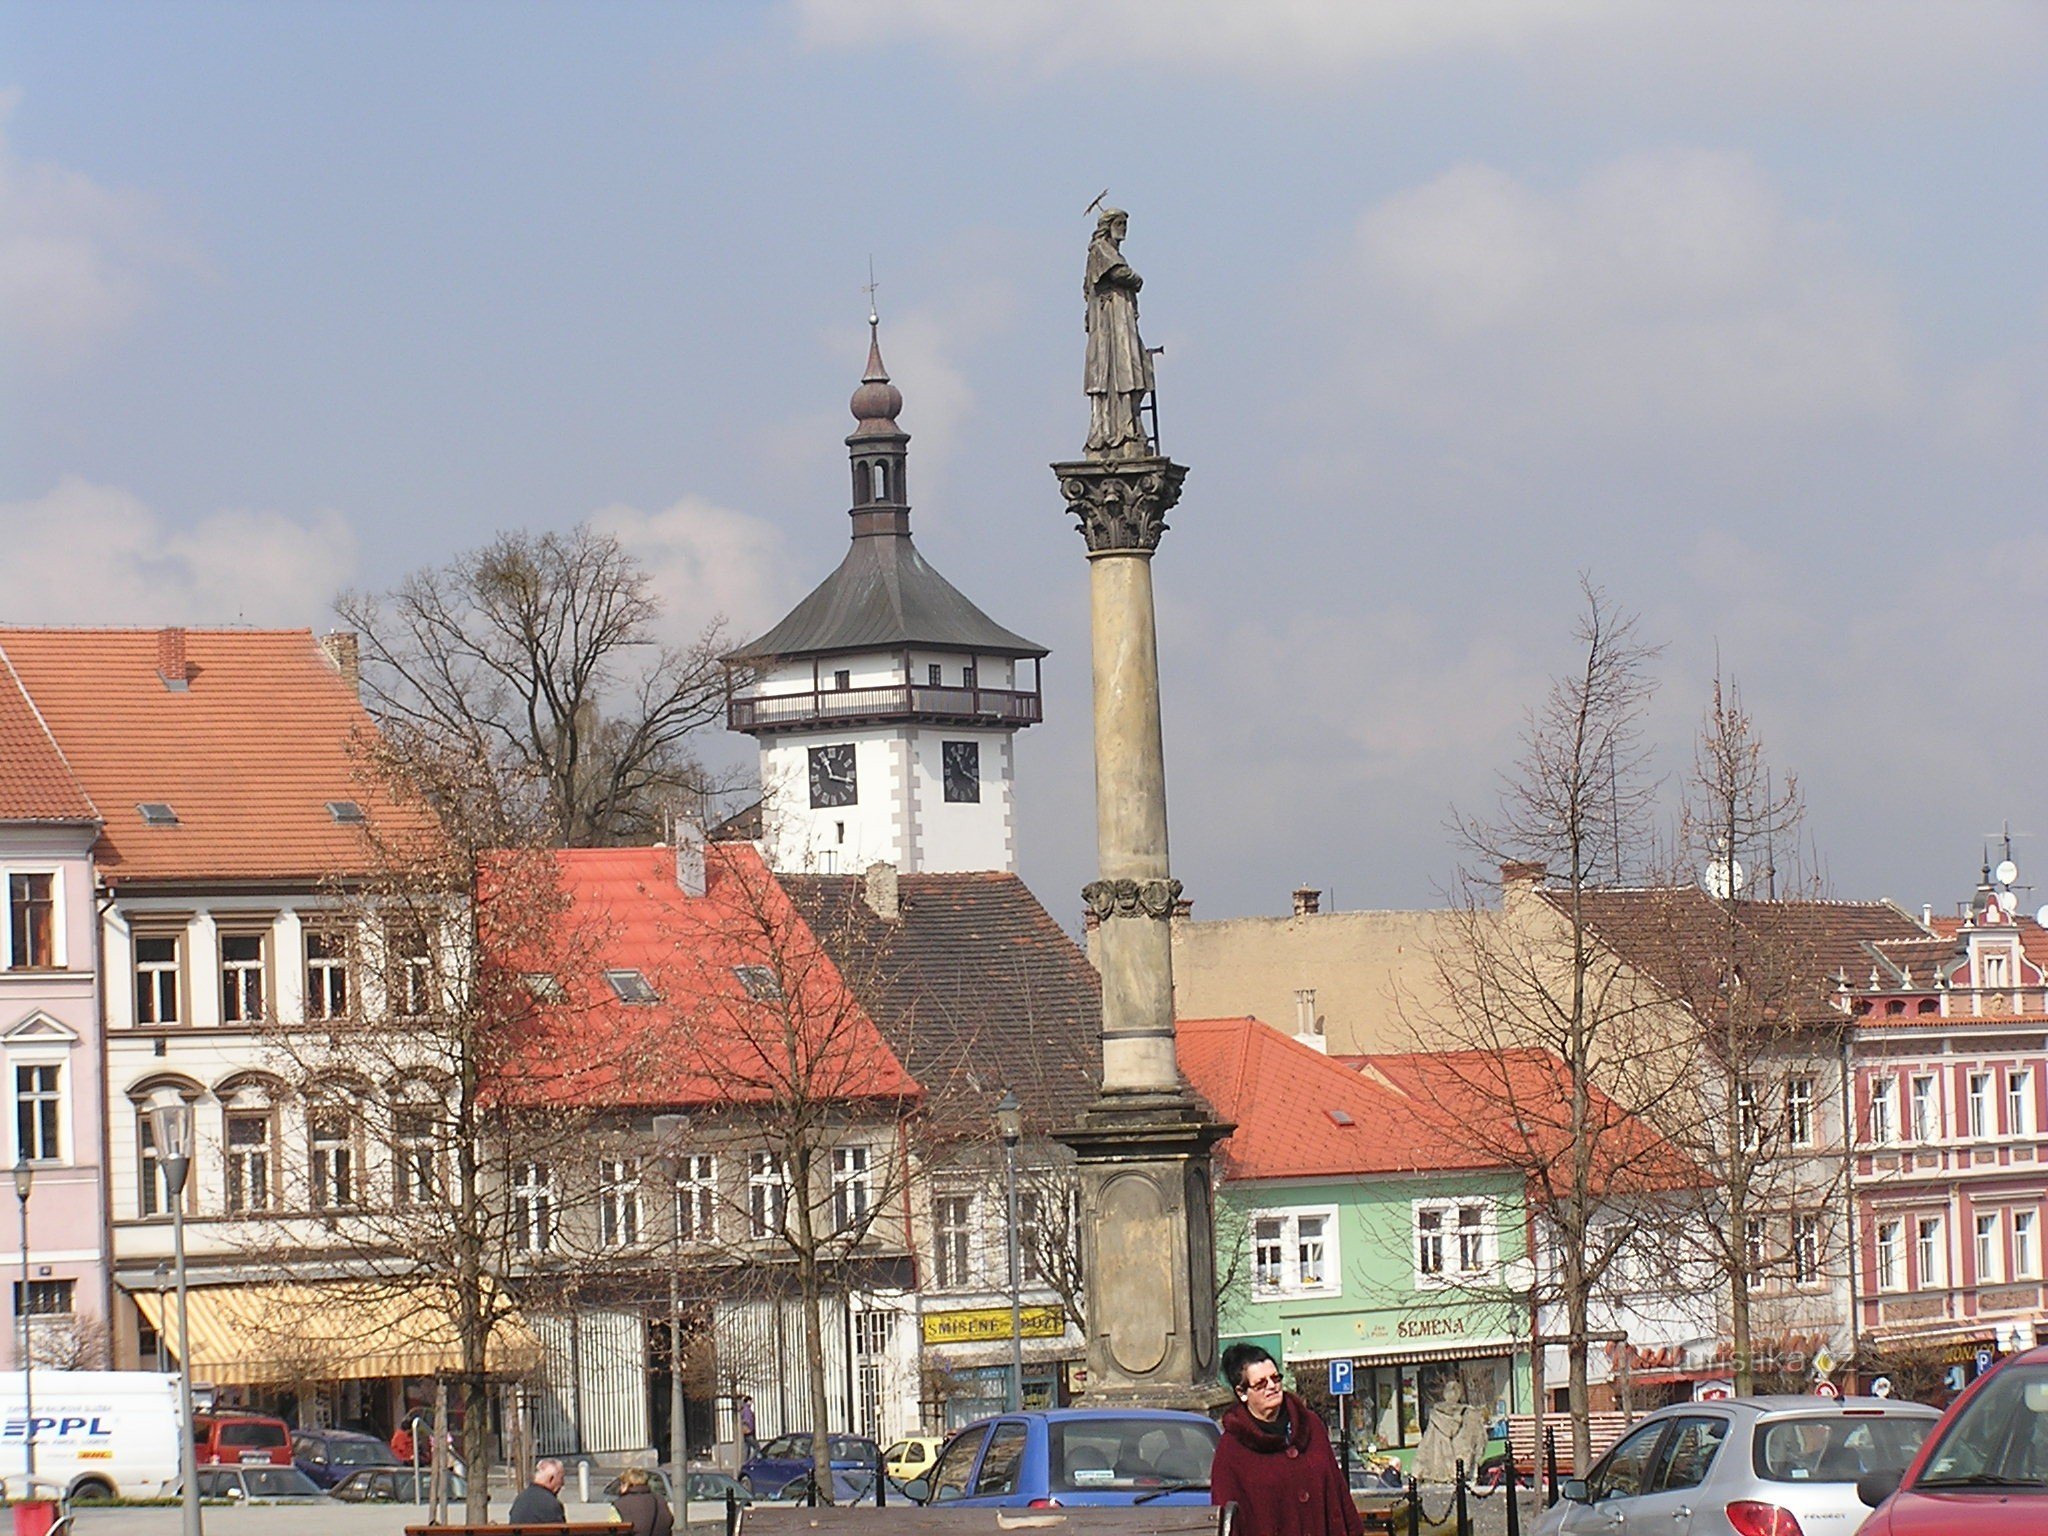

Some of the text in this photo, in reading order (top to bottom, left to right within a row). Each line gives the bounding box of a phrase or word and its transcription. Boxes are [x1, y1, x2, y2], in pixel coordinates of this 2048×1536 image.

[1397, 1318, 1465, 1338] SEMENA
[1980, 1353, 1989, 1371] P
[1336, 1363, 1349, 1383] P
[29, 1417, 112, 1436] PPL
